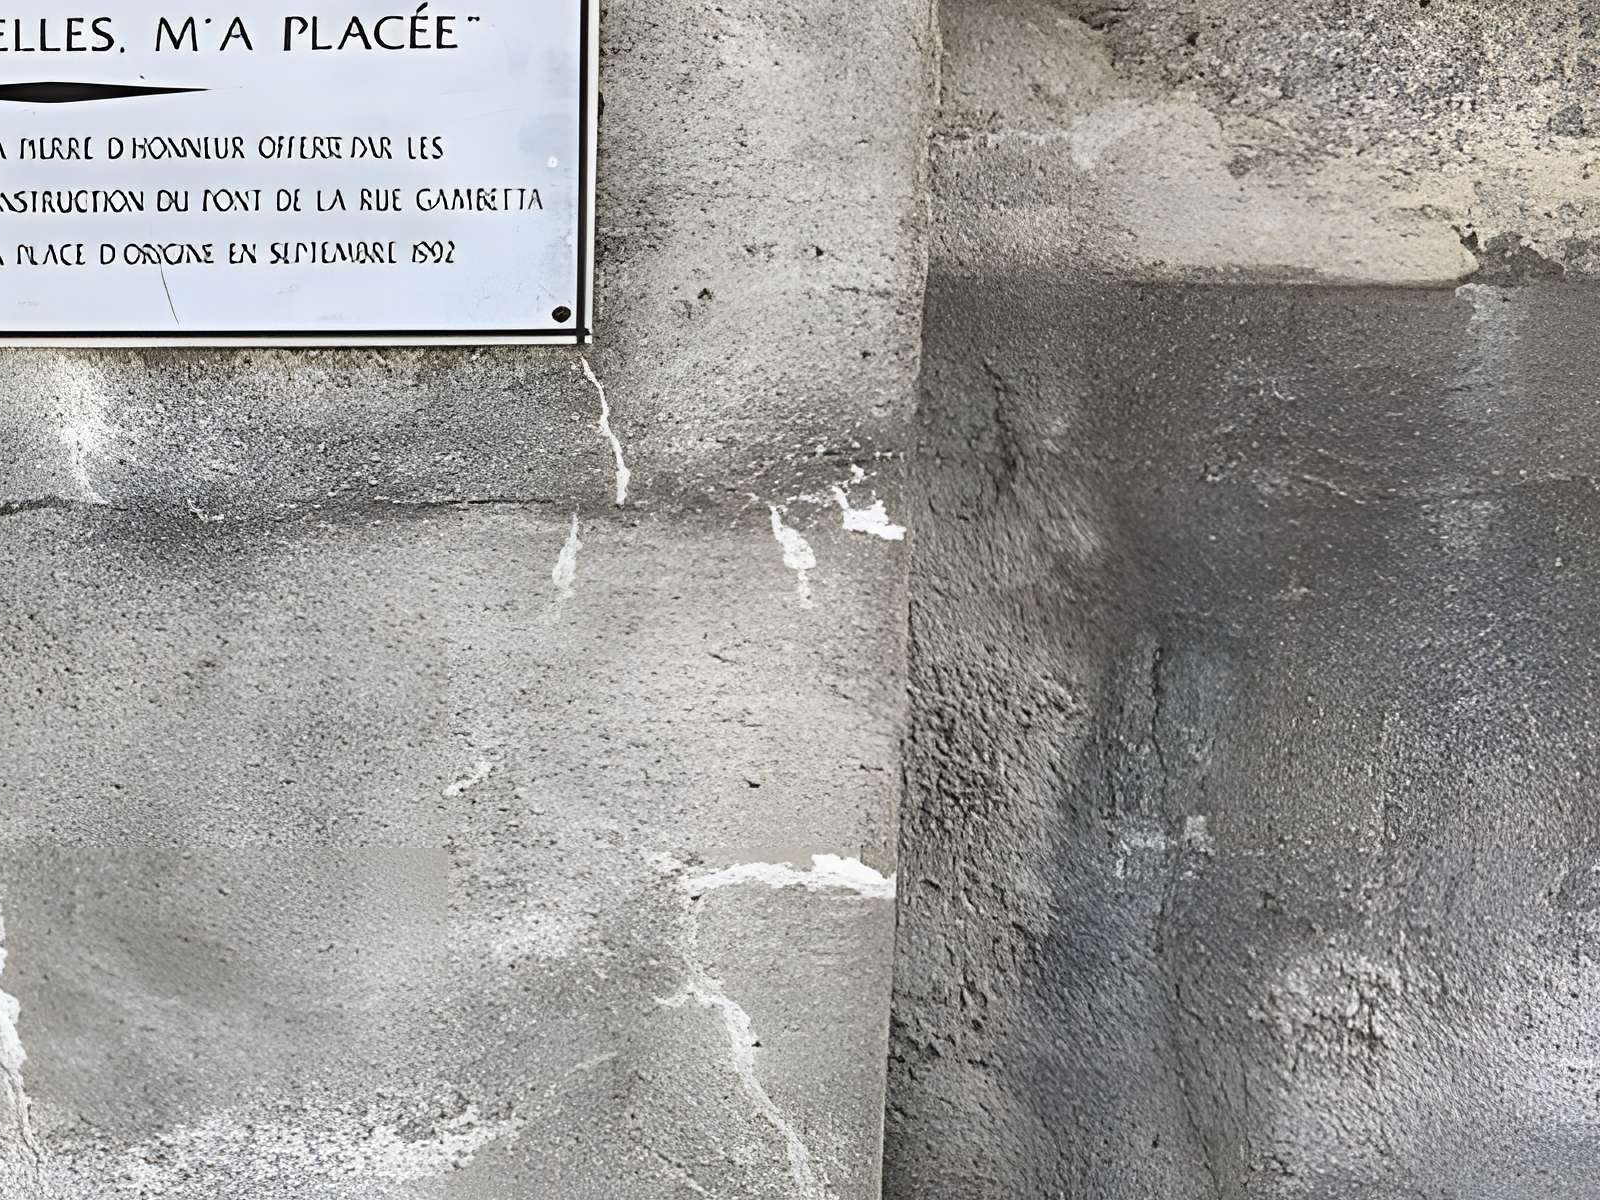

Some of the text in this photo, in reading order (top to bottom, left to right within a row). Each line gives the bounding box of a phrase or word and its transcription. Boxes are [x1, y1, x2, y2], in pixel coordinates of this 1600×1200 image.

[155, 16, 254, 52] M'A
[407, 136, 444, 160] LES
[156, 189, 189, 212] DU
[202, 188, 261, 212] PONT
[276, 188, 302, 212] DE
[317, 188, 346, 212] LA
[359, 188, 402, 212] RUE
[416, 187, 544, 212] GAMBETTA
[228, 242, 257, 265] EN
